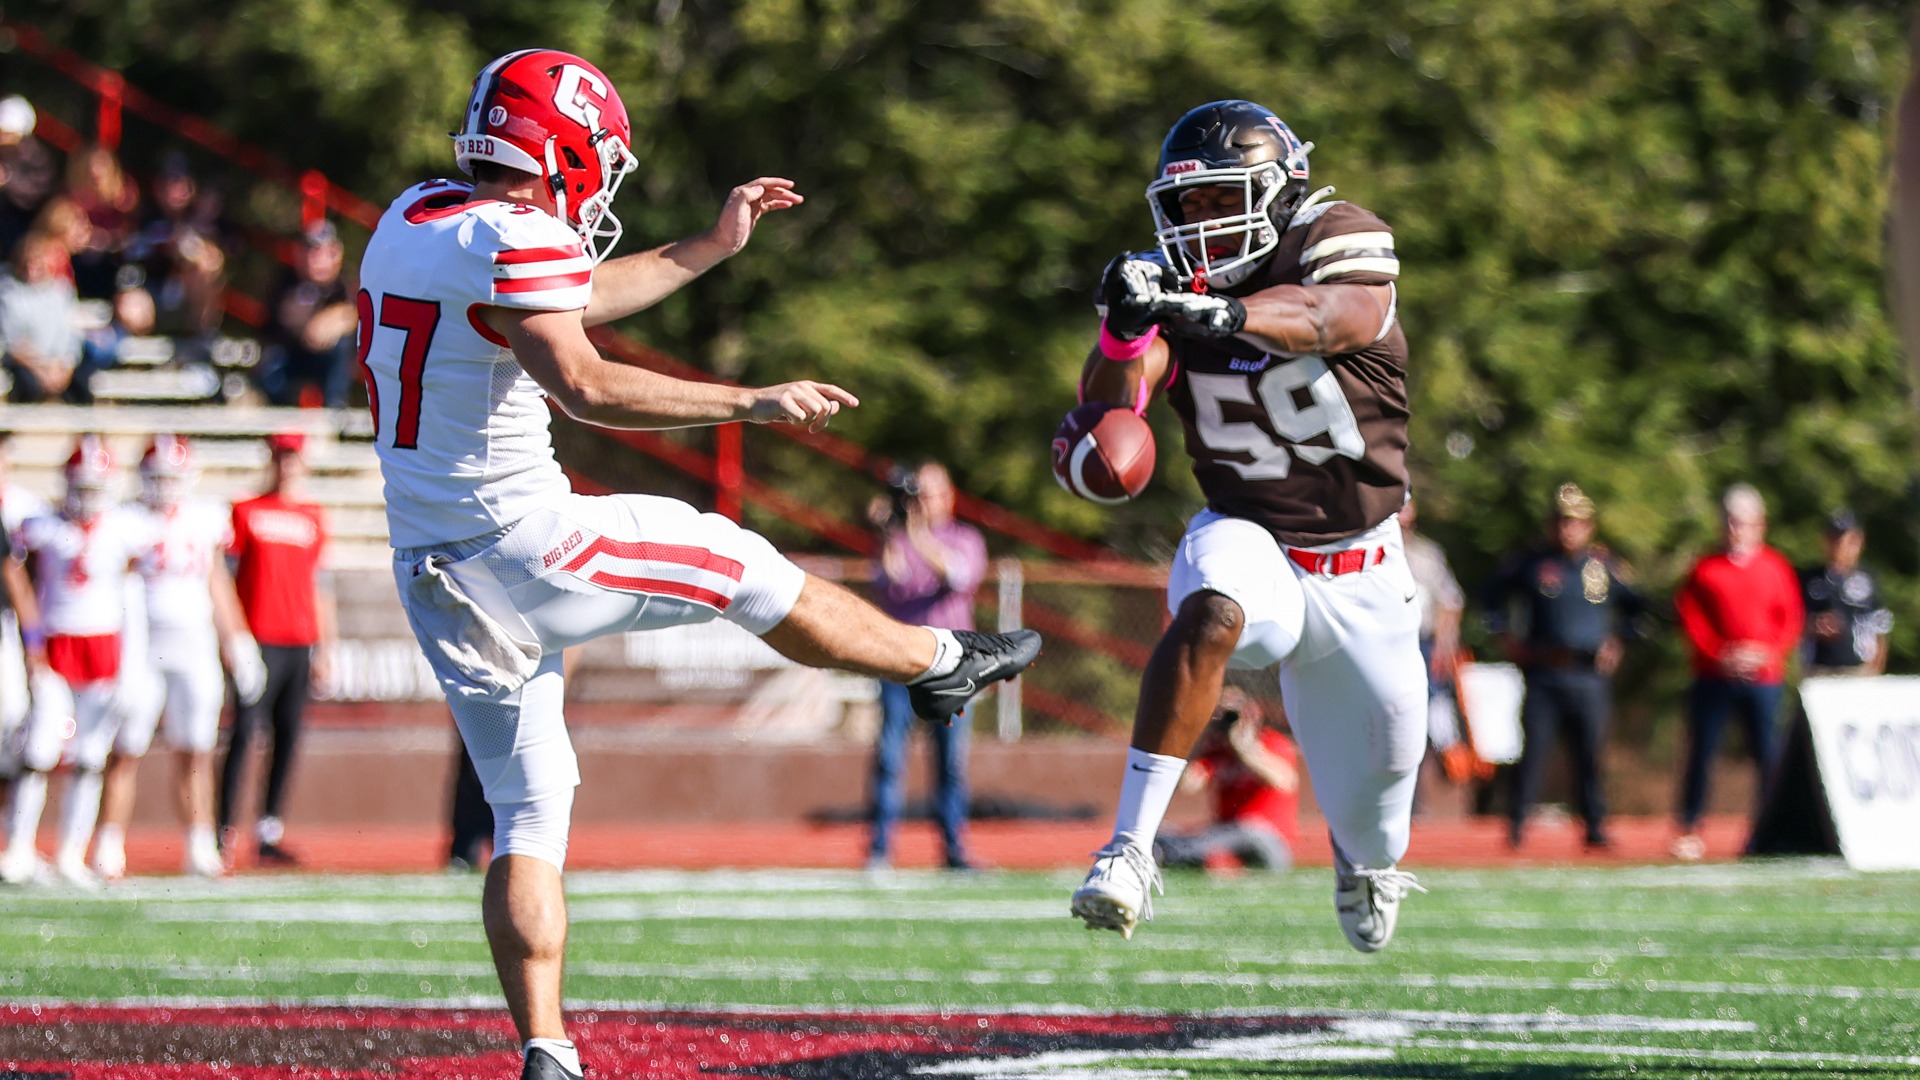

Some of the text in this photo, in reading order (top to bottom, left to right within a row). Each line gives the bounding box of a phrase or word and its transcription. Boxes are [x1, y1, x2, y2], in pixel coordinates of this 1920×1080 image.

[490, 109, 503, 123] 37
[467, 137, 495, 157] RED
[1229, 351, 1272, 373] BRO
[1186, 354, 1366, 481] 59
[542, 530, 583, 569] BIG RED
